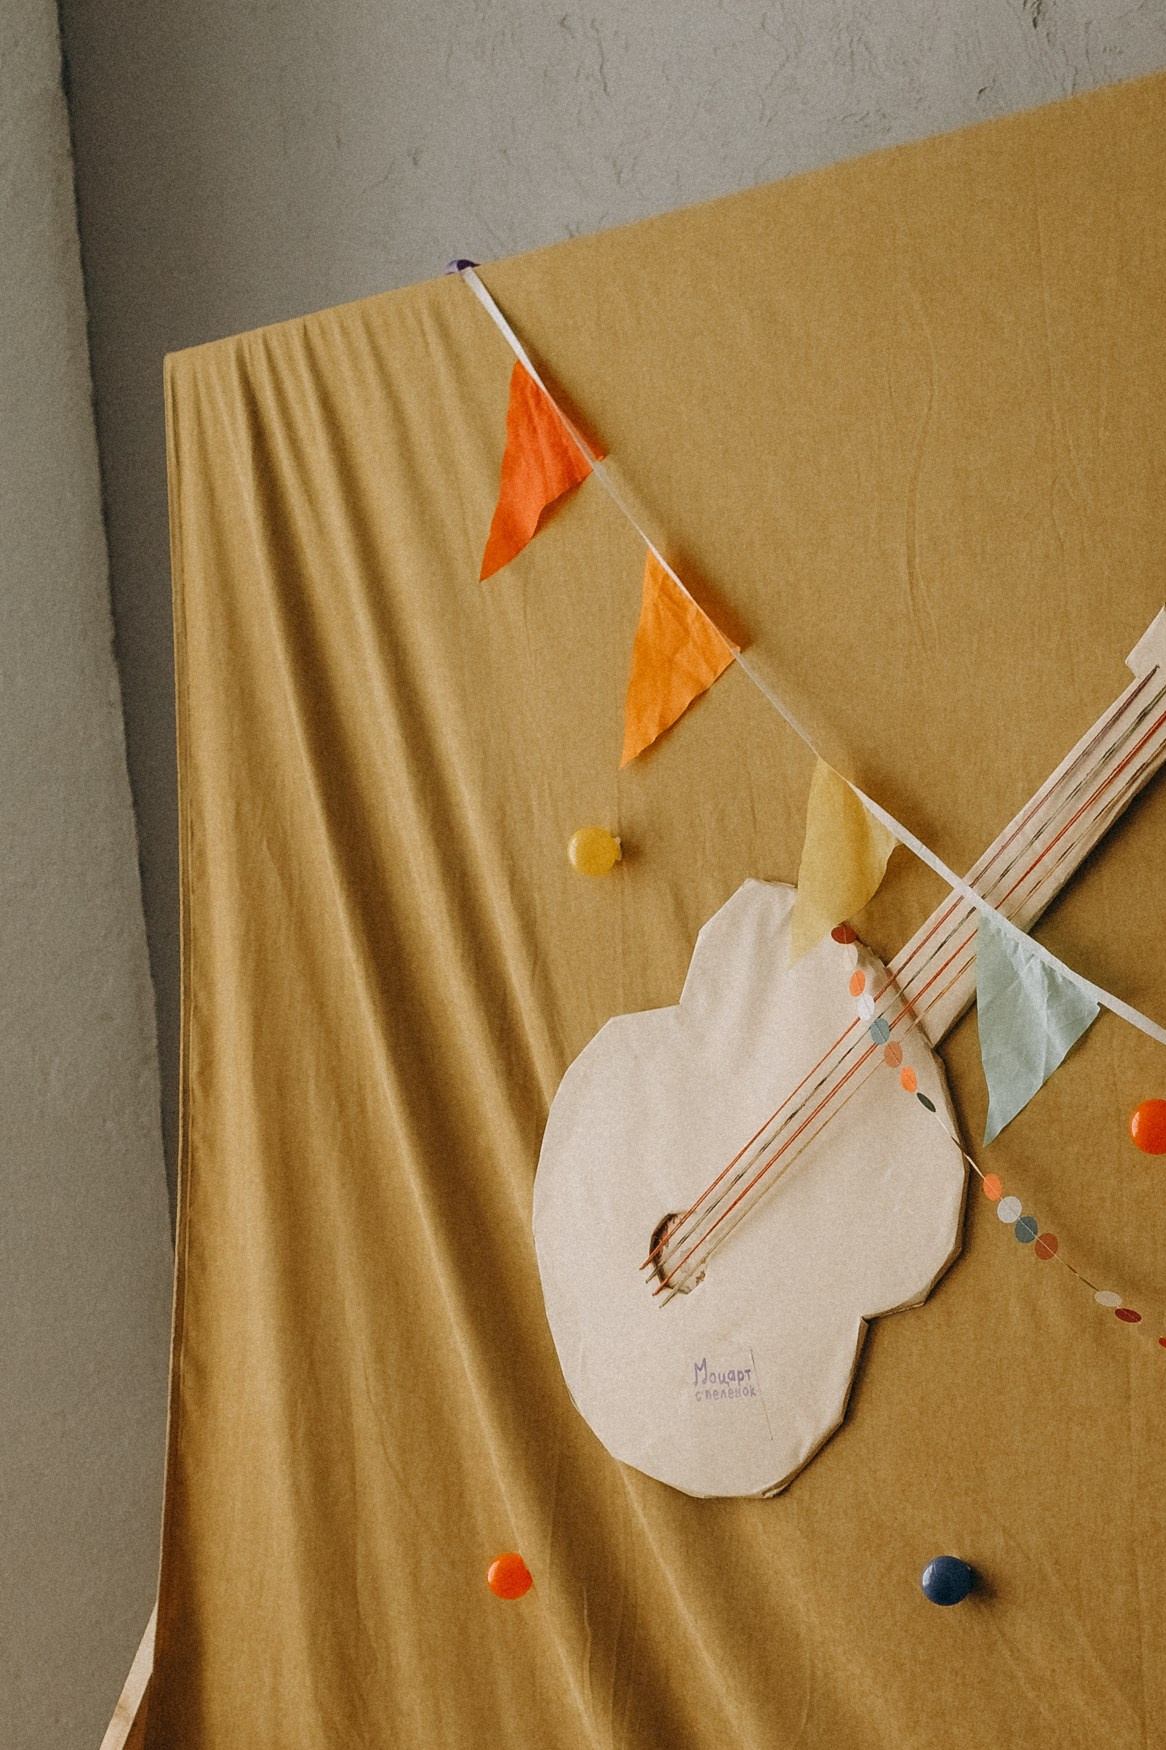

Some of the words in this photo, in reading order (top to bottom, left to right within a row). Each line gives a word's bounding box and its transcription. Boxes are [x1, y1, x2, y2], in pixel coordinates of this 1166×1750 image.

[693, 1358, 751, 1386] Моцарт
[695, 1391, 702, 1402] с
[705, 1385, 757, 1400] пеленок
